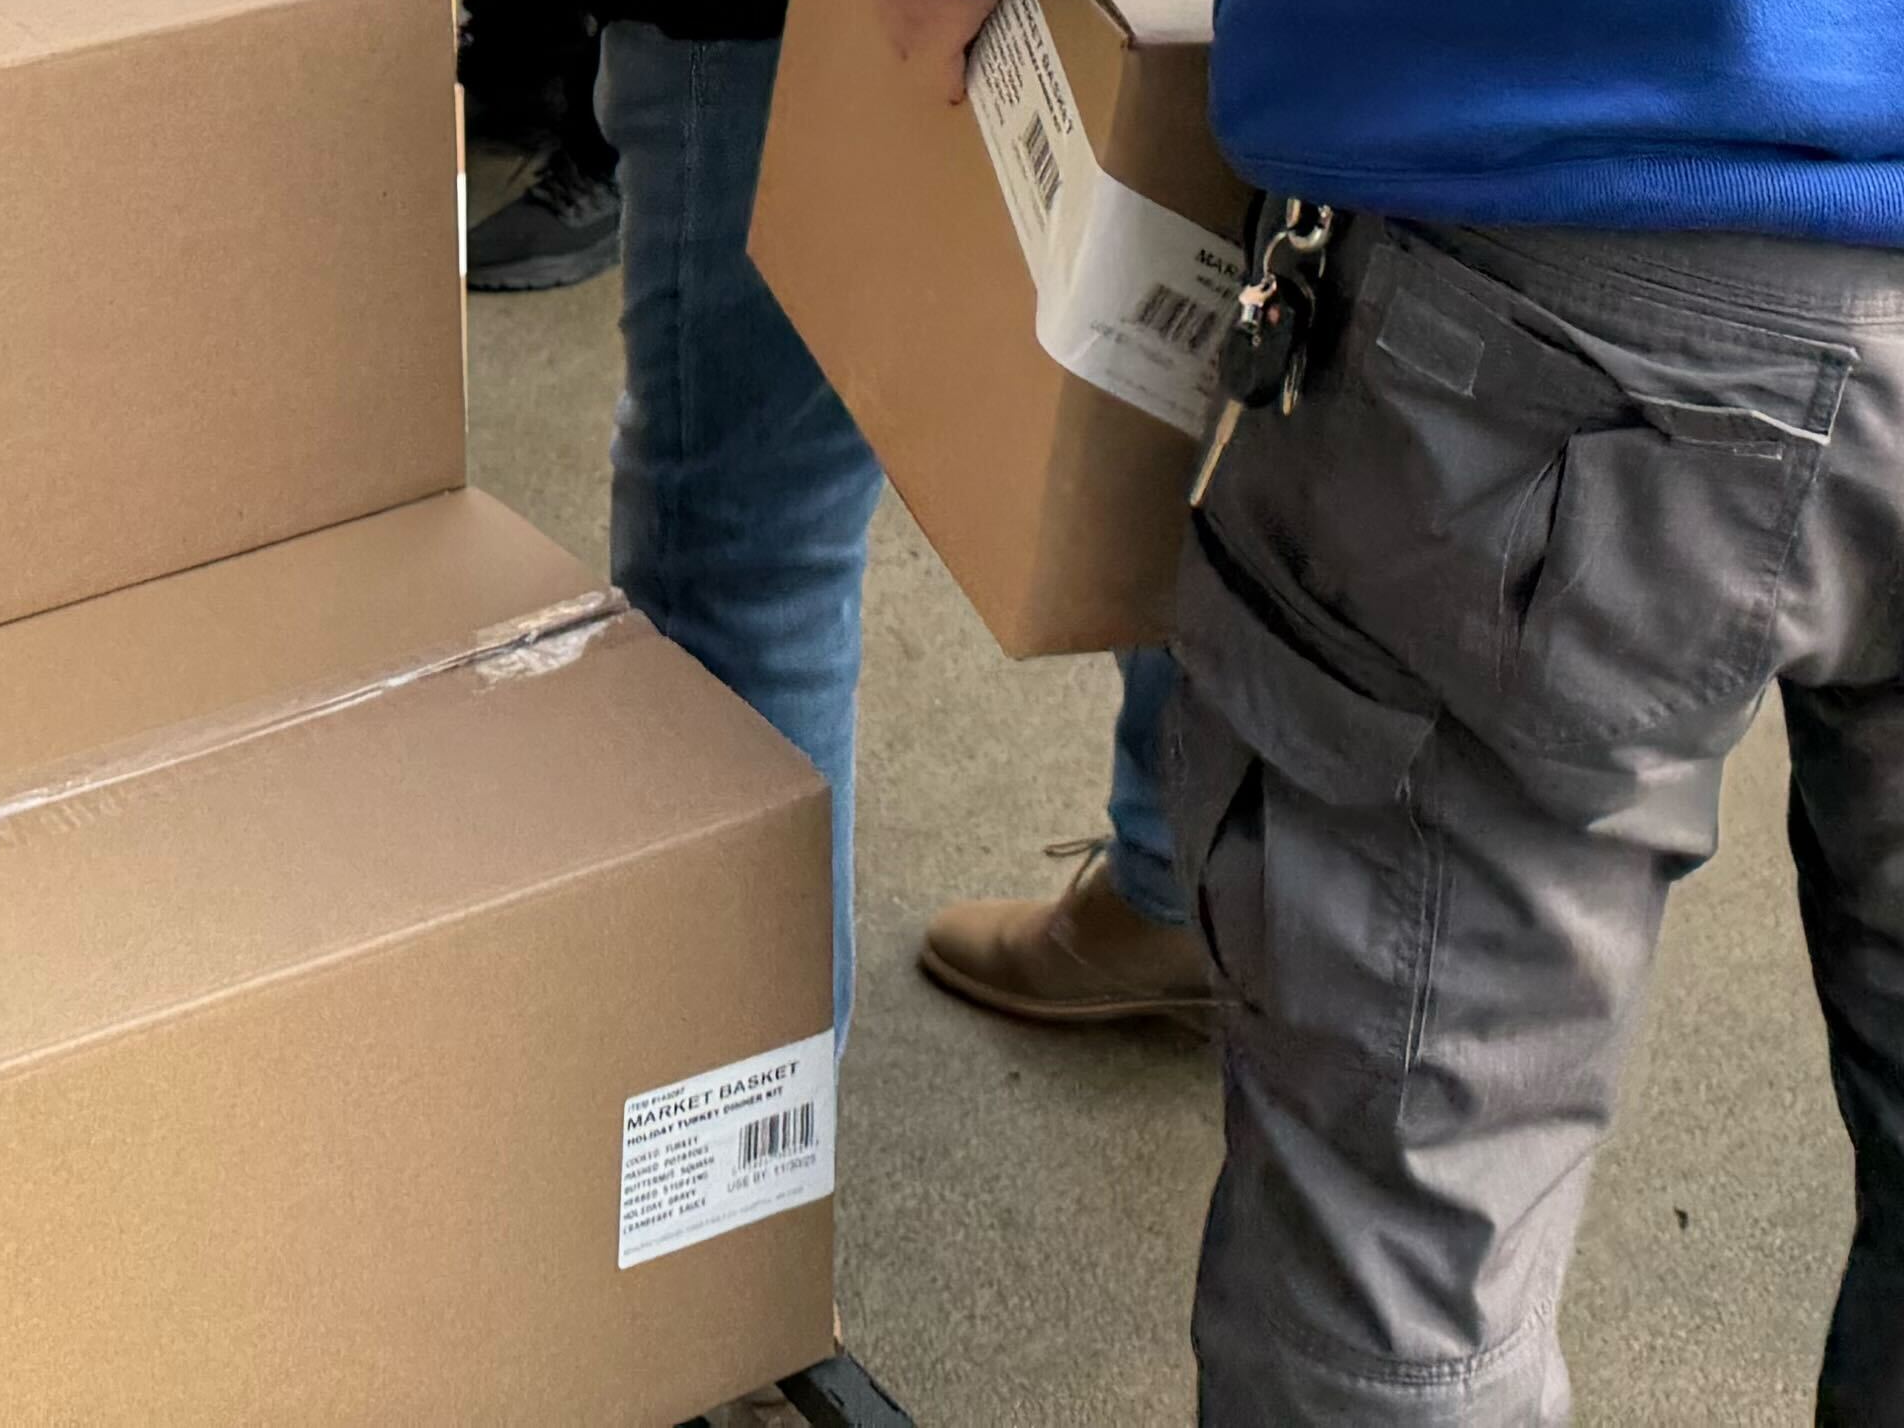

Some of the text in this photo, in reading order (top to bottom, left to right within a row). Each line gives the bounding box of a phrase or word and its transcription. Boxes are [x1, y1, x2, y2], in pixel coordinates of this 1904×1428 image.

[627, 1060, 801, 1131] MARKET BASKET
[627, 1085, 784, 1148] HOLIDAY TURKEY DINNER KIT
[624, 1162, 659, 1180] MASHED
[664, 1145, 709, 1167] POTATOES
[665, 1136, 698, 1154] TURKEY
[624, 1169, 675, 1195] BUTTERNUT
[680, 1157, 715, 1177] SQUASH
[663, 1172, 709, 1195] STUFFING
[727, 1175, 749, 1193] USE
[753, 1170, 766, 1184] BY
[623, 1190, 696, 1221] HOLIDAY GRAVY
[623, 1197, 706, 1235] CRANBERRY SAUCE
